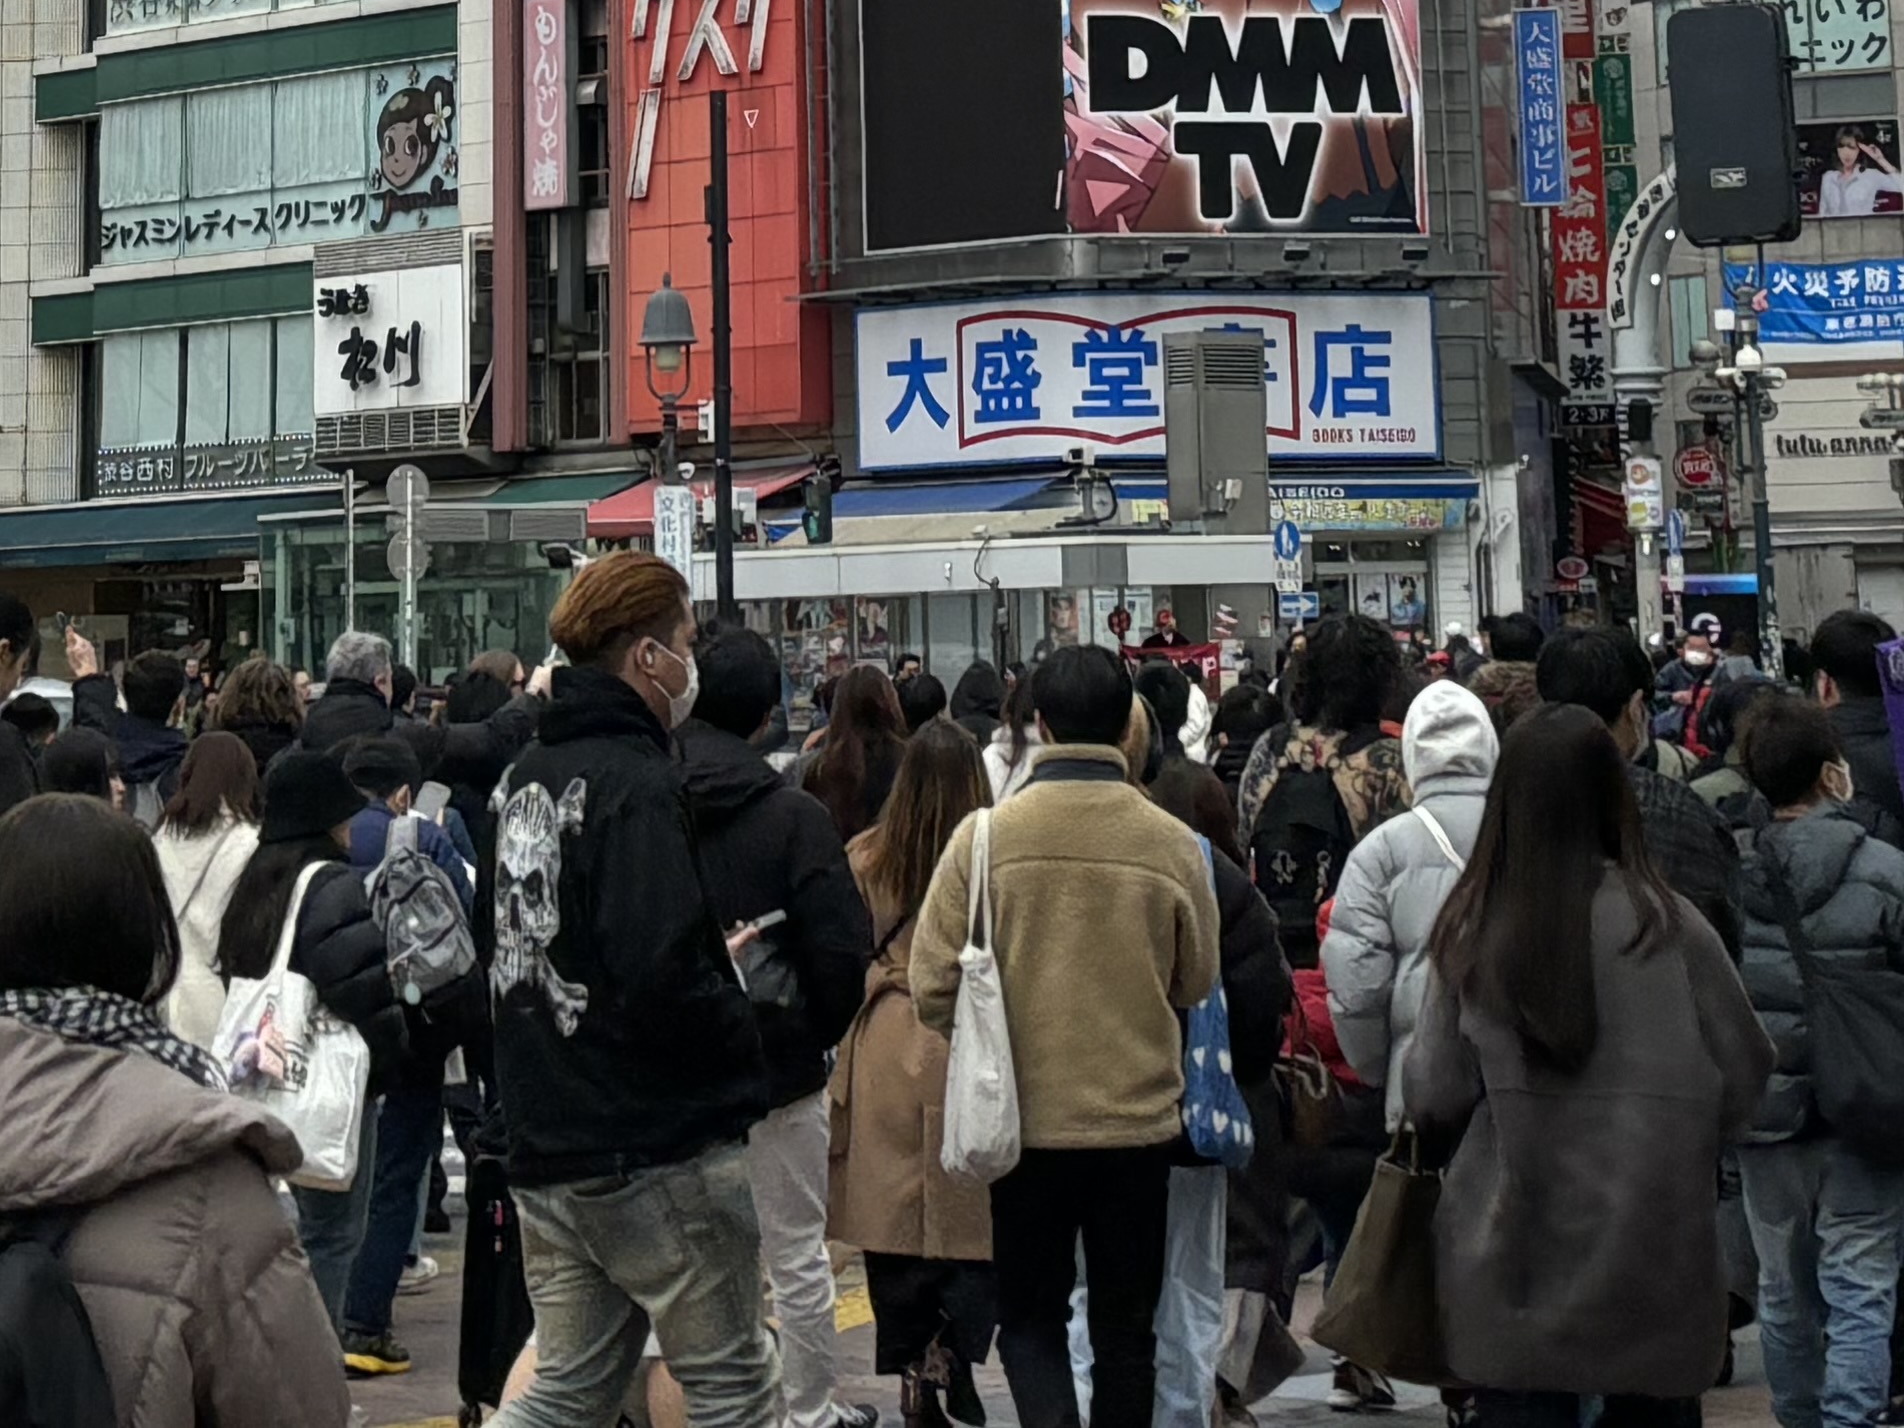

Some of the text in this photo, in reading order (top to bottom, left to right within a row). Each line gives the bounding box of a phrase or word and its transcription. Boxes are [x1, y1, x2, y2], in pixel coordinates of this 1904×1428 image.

[1087, 13, 1403, 113] DMM
[1173, 121, 1323, 220] TV
[884, 322, 1394, 434] 大盛堂店
